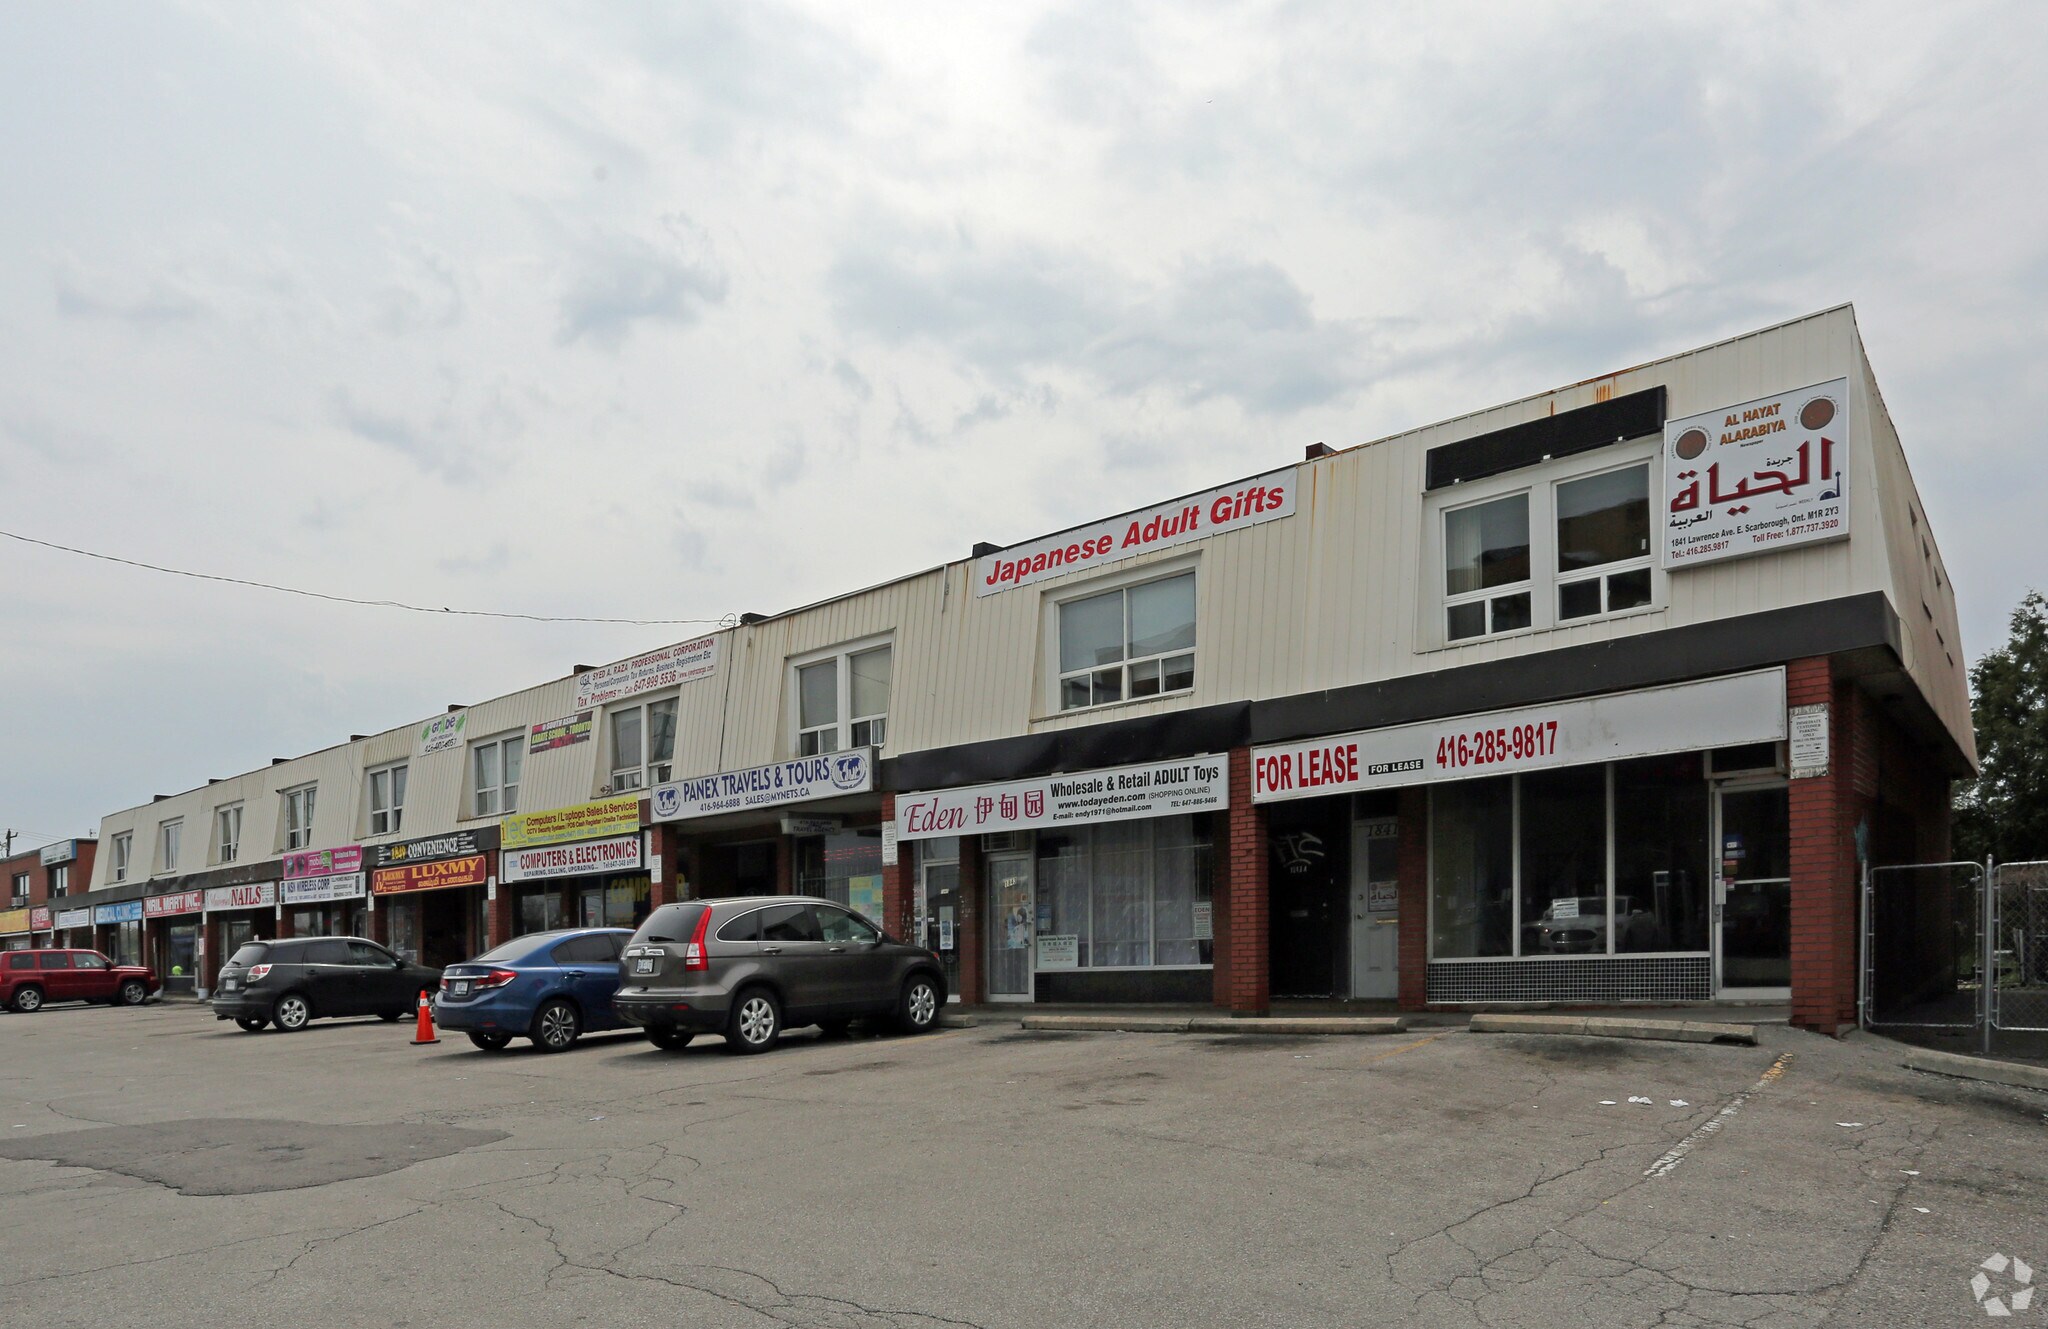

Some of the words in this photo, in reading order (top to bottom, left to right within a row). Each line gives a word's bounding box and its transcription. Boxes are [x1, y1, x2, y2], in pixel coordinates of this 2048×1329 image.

[1724, 414, 1740, 427] AL
[1743, 403, 1781, 423] HAYAT
[1720, 420, 1786, 445] ALARABIYA
[1766, 455, 1793, 467] جريدة
[1670, 437, 1835, 516] الحياة
[1669, 509, 1713, 530] العربية
[1671, 536, 1687, 547] 1841
[1688, 532, 1720, 544] Lawrence
[1721, 527, 1735, 538] Ave.
[1737, 525, 1744, 534] E.
[1745, 517, 1790, 533] Scarborough,
[1791, 512, 1806, 523] Ont.
[1808, 508, 1824, 519] M1R
[1825, 506, 1839, 516] 2Y3
[1752, 533, 1765, 544] Toll
[1766, 530, 1784, 541] Free:
[1785, 518, 1839, 538] 1.877.737.3920
[986, 535, 1113, 585] Japanese
[1121, 505, 1199, 549] Adult
[1210, 487, 1284, 524] Gifts
[1686, 540, 1730, 556] 416.285.9817
[613, 666, 628, 674] RAZA
[631, 650, 671, 670] PROFESSIONAL
[673, 637, 715, 657] CORPORATION
[656, 661, 676, 673] Business
[676, 654, 703, 668] Registration
[577, 696, 588, 708] Tax
[590, 689, 617, 704] Problems
[1256, 754, 1293, 793] FOR
[1298, 743, 1359, 788] LEASE
[1436, 722, 1558, 769] 416-285-9817
[1370, 764, 1389, 774] FOR
[1391, 760, 1422, 772] LEASE
[683, 778, 719, 802] PANEX
[721, 770, 771, 796] TRAVELS
[774, 766, 784, 788] &
[786, 757, 830, 783] TOURS
[1050, 778, 1103, 798] Wholesale
[1106, 776, 1115, 791] &
[1118, 771, 1151, 790] Retail
[1154, 766, 1190, 786] ADULT
[1193, 765, 1220, 783] Toys
[699, 799, 741, 812] 416-964-6888
[745, 787, 811, 806] SALES@MYNETS.CA
[974, 789, 1044, 825] 伊甸园
[1058, 792, 1146, 810] www.todayeden.com
[1148, 788, 1184, 800] (SHOPPING
[1184, 785, 1211, 796] ONLINE)
[1170, 800, 1181, 808] TEL:
[526, 814, 557, 827] Computers
[560, 809, 586, 822] Laptops
[586, 806, 603, 817] Sales
[604, 804, 609, 813] &
[609, 801, 638, 814] Services
[903, 797, 969, 833] Eden
[1053, 811, 1074, 820] E-mail:
[1075, 804, 1152, 819] endy1971@hotmail.com
[1368, 824, 1398, 837] 1841
[407, 837, 459, 859] CONVENIENCE
[520, 849, 566, 870] COMPUTERS
[569, 850, 574, 865] &
[575, 840, 637, 864] ELECTRONICS
[411, 858, 479, 879] LUXMY
[523, 868, 548, 878] REPAIRING,
[548, 866, 568, 875] SELLING,
[146, 898, 162, 912] NAIL
[163, 895, 184, 911] MART
[184, 893, 201, 908] INC.
[231, 886, 262, 907] NAILS
